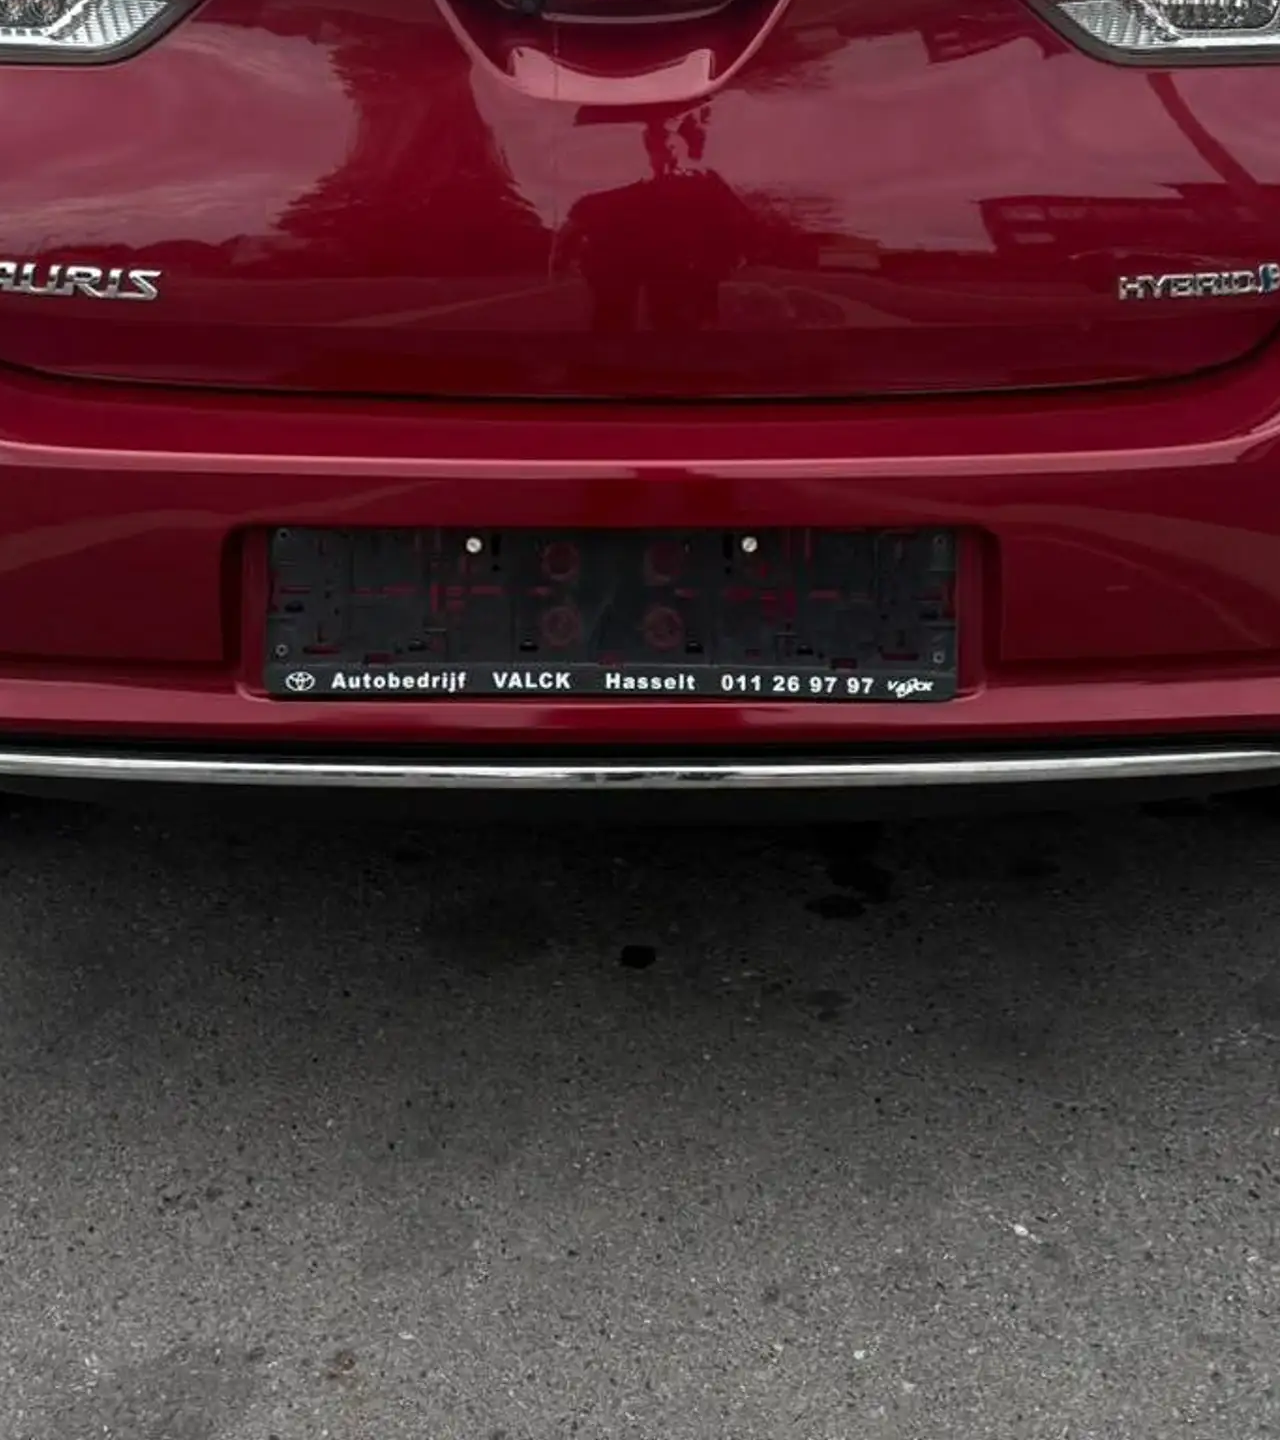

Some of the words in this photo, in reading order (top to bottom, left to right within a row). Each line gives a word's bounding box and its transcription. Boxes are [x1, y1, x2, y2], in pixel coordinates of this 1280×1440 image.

[1118, 269, 1256, 300] HYBRID
[331, 671, 467, 693] Autobedrijf
[492, 672, 571, 690] VALCK
[604, 672, 696, 691] Hasselt
[721, 674, 761, 693] 011
[772, 674, 801, 693] 26
[809, 675, 837, 694] 97
[846, 676, 874, 695] 97
